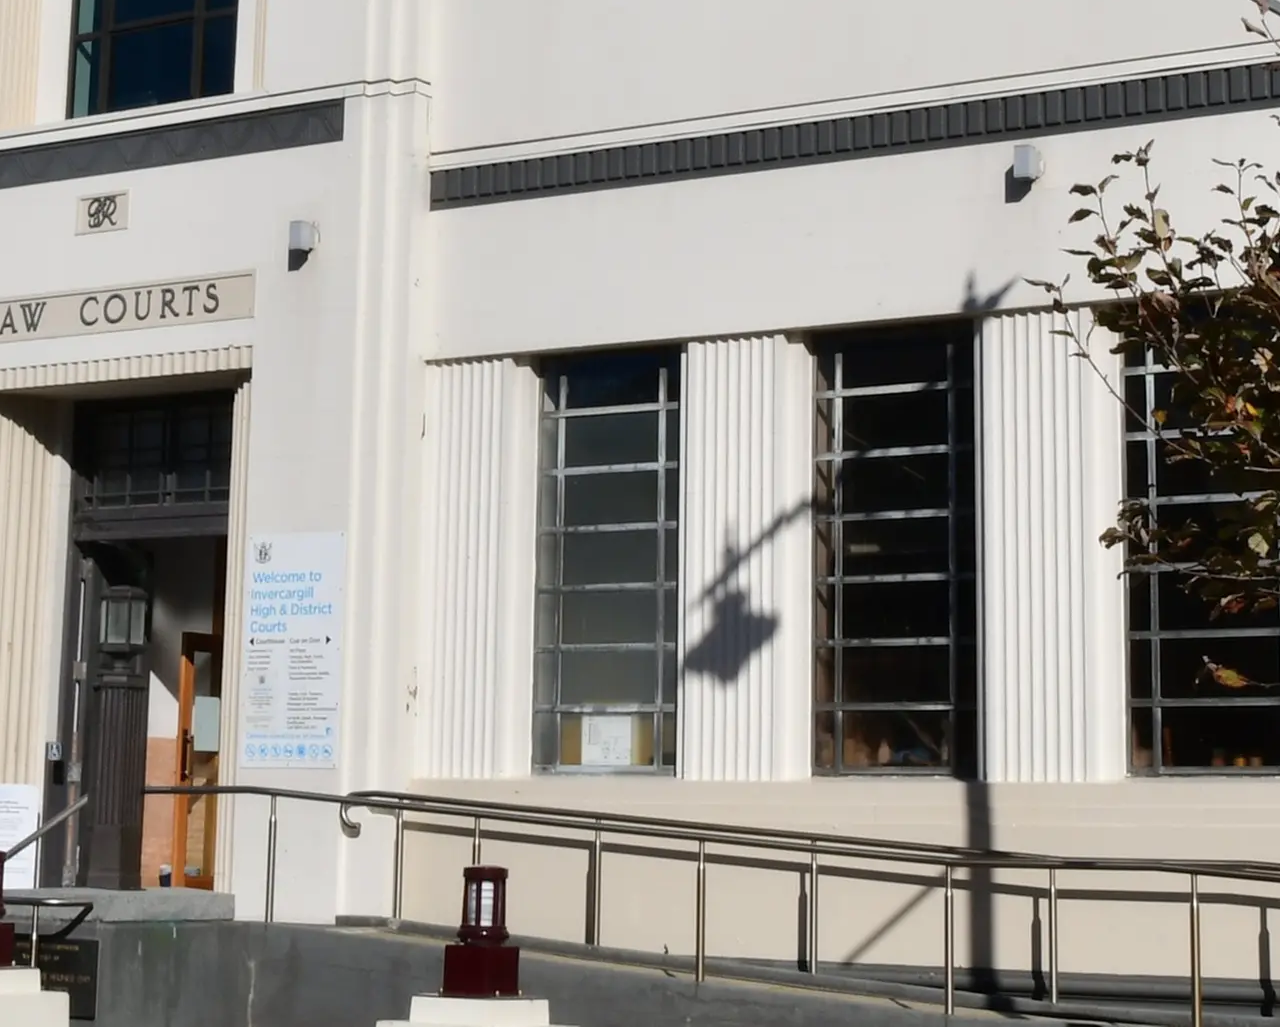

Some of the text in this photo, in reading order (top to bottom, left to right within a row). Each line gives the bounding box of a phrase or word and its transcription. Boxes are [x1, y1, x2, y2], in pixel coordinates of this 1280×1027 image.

[80, 283, 220, 327] COURTS
[252, 571, 322, 584] Welcome to
[250, 586, 314, 601] Invercargill
[250, 603, 332, 619] High & District
[250, 620, 287, 634] Courts
